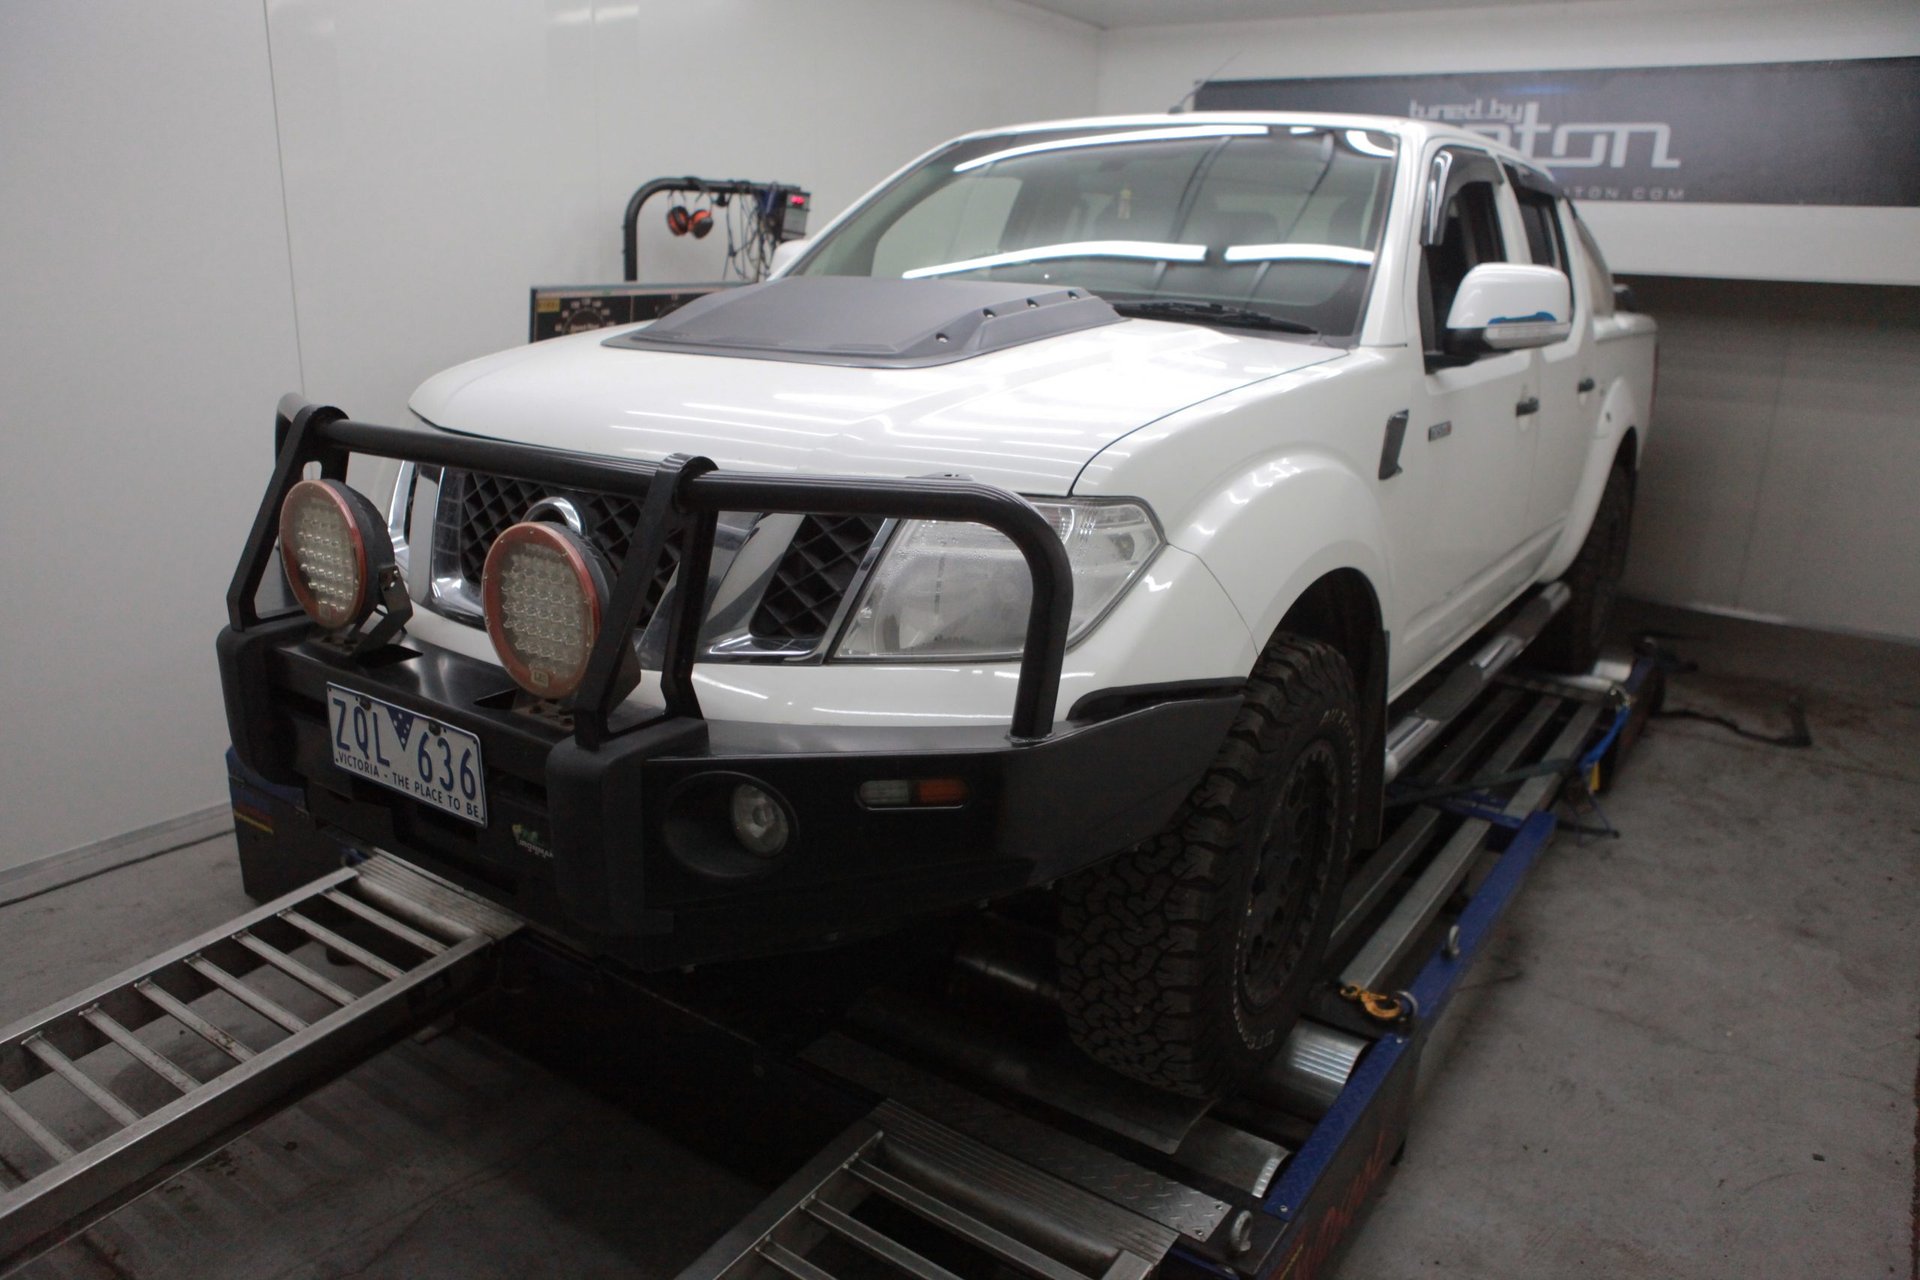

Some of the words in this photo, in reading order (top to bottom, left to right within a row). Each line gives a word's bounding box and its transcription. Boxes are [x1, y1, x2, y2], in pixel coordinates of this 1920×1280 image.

[1409, 99, 1482, 119] tuned
[1490, 98, 1523, 122] by
[333, 698, 390, 767] ZQL
[417, 731, 476, 801] 636
[338, 752, 380, 778] VICTORIA
[392, 772, 410, 790] THE
[414, 783, 443, 804] PLACE
[448, 796, 461, 811] TO
[466, 804, 479, 818] BE
